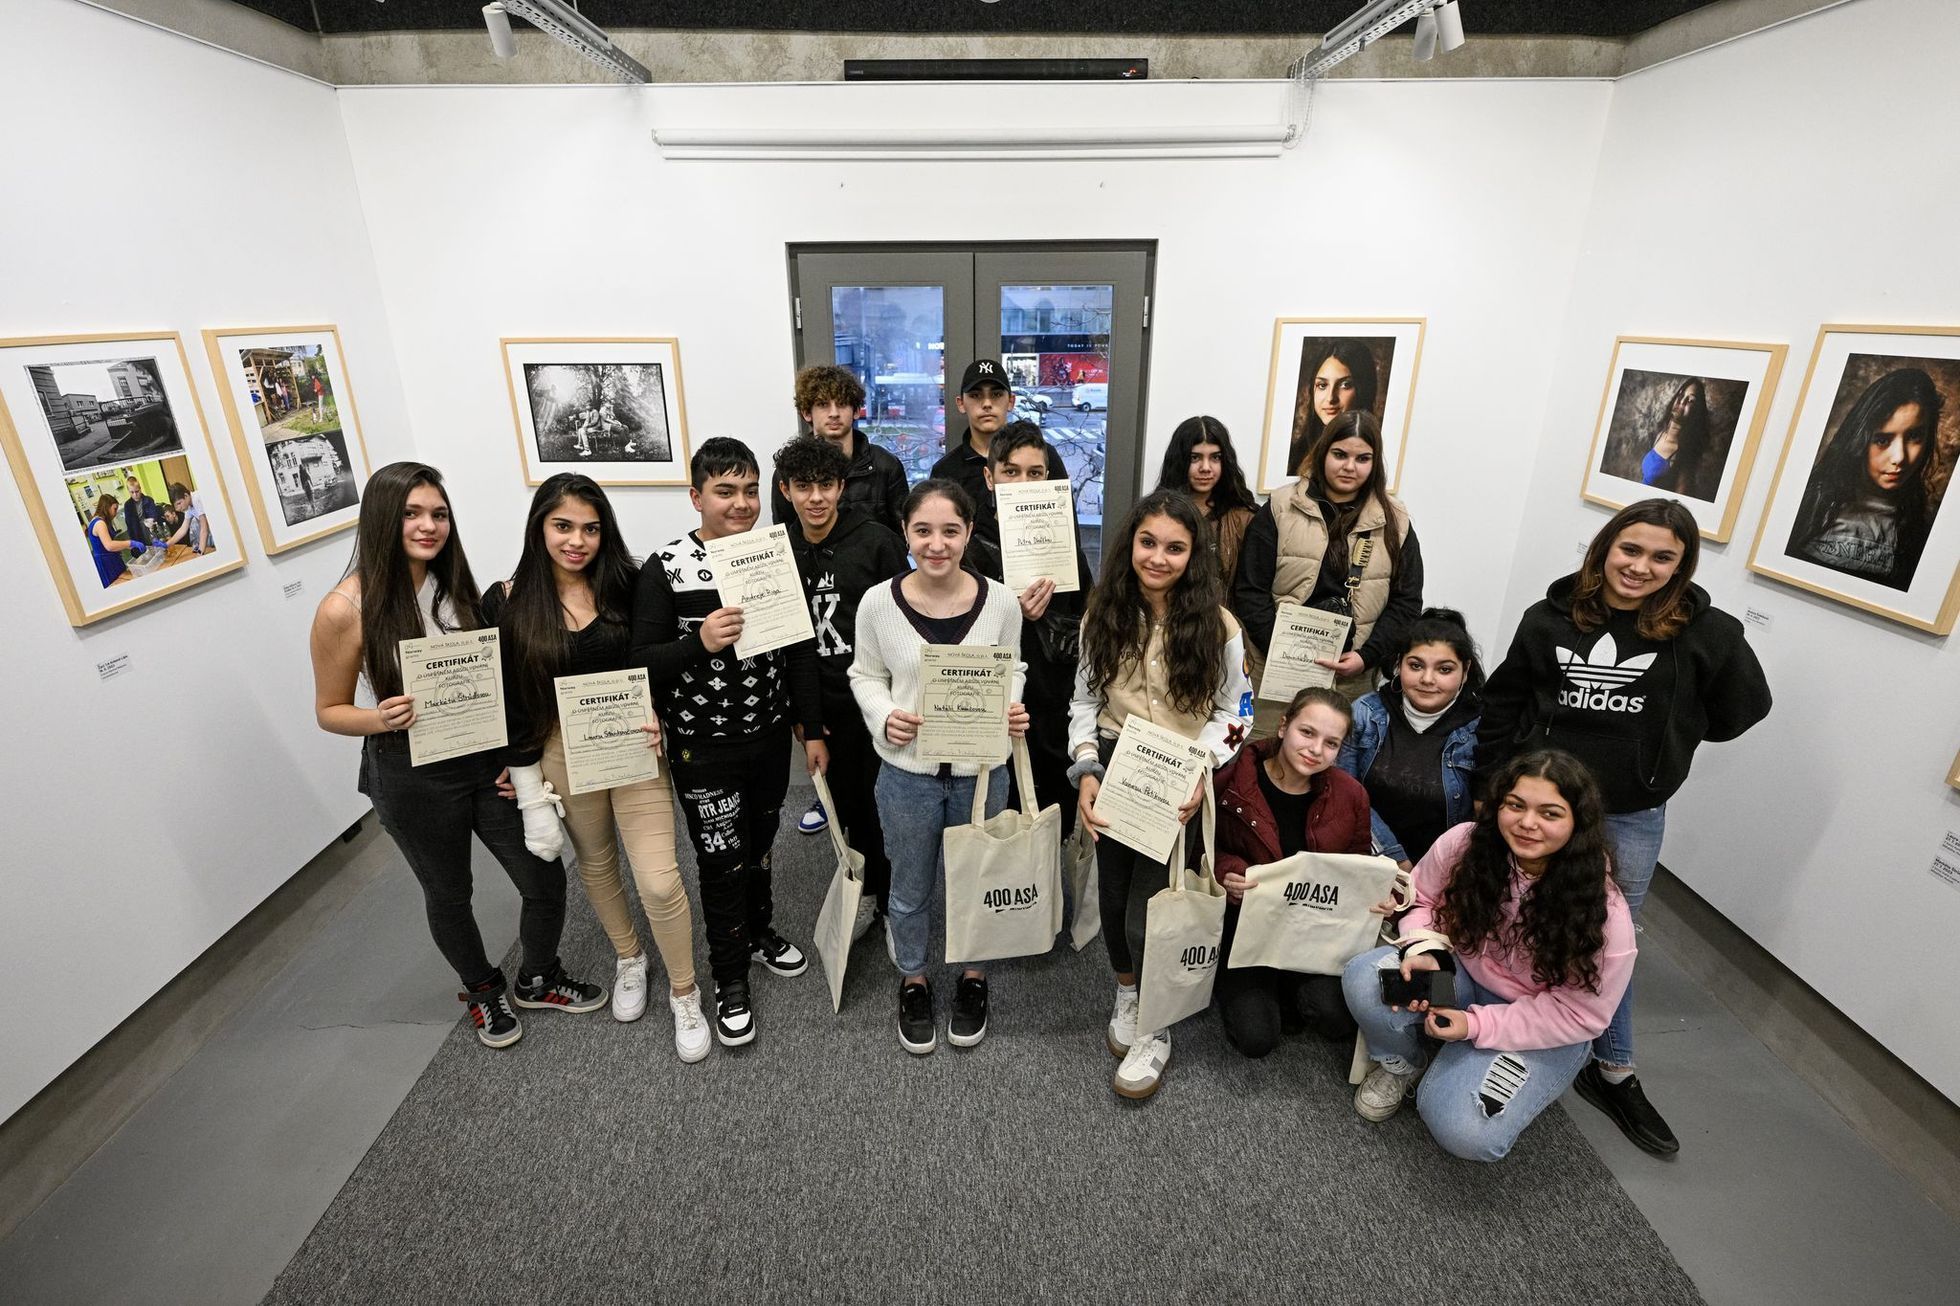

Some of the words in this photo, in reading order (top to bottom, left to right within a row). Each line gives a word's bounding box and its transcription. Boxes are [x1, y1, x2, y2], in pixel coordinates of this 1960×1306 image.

[979, 362, 994, 374] NY
[1016, 502, 1056, 512] CERTIFIKÁT
[731, 551, 774, 567] CERTIFIKÁT
[812, 594, 852, 656] K
[1290, 624, 1329, 637] CERTIFIKÁT
[426, 655, 479, 670] CERTIFIKÁT
[942, 669, 991, 677] CERTIFIKÁT
[580, 693, 629, 705] CERTIFIKÁT
[1558, 688, 1644, 713] adidas
[1137, 745, 1182, 769] CERTIFIKÁT
[1188, 746, 1198, 755] 400
[698, 803, 717, 818] RTR
[718, 792, 740, 813] JEANS
[700, 831, 726, 853] 34
[984, 888, 1011, 908] 400
[1014, 883, 1038, 905] ASA
[1284, 882, 1310, 902] 400
[1309, 883, 1339, 905] ASA
[1180, 946, 1206, 966] 400
